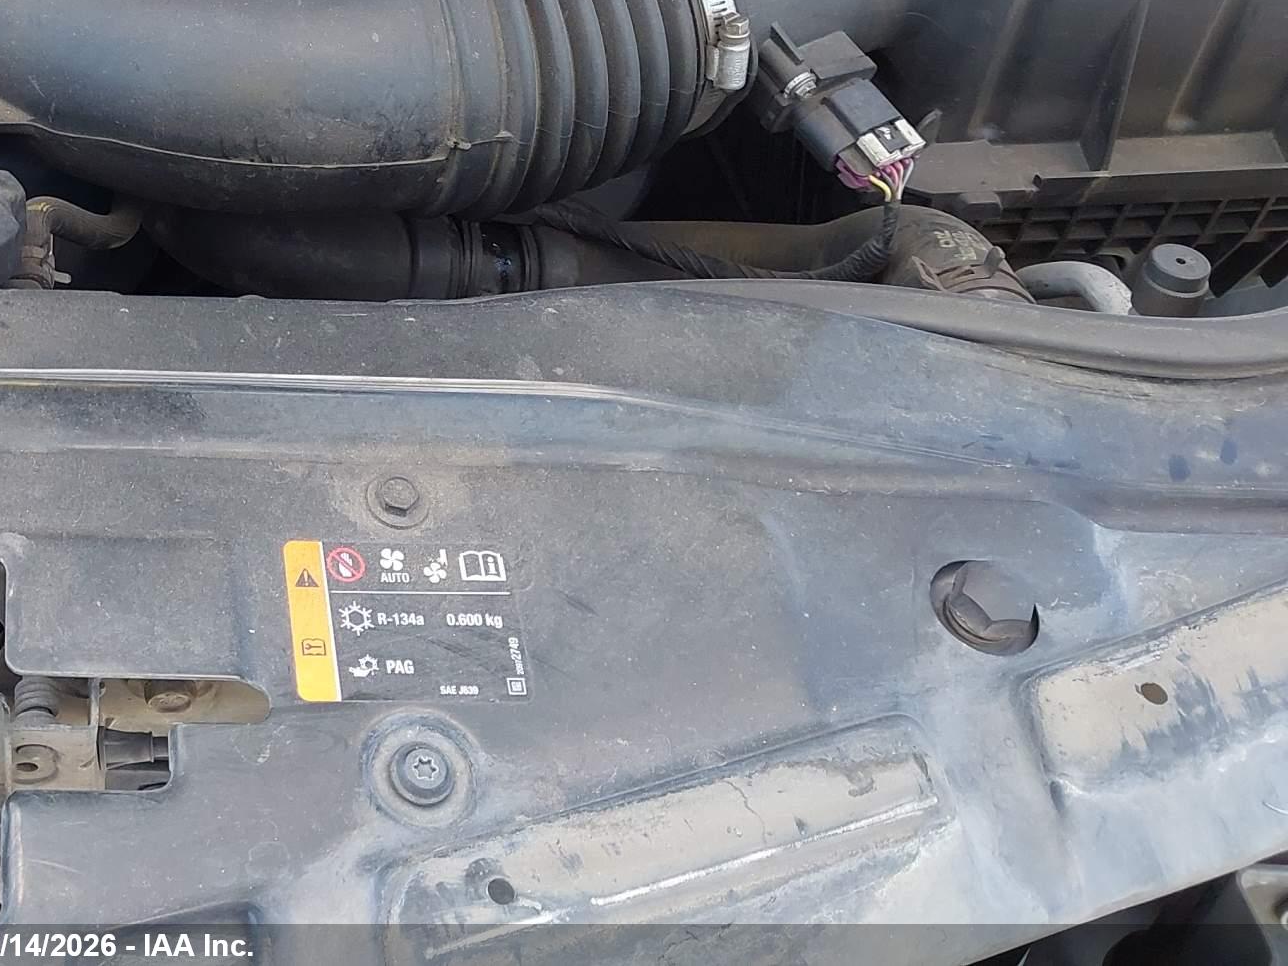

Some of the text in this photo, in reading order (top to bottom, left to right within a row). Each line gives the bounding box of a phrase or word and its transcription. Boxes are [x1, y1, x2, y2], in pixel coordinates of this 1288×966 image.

[380, 572, 410, 583] AUTO
[377, 612, 504, 629] R-134a 0.600 kg
[385, 659, 415, 675] PAG
[439, 685, 457, 695] SAE
